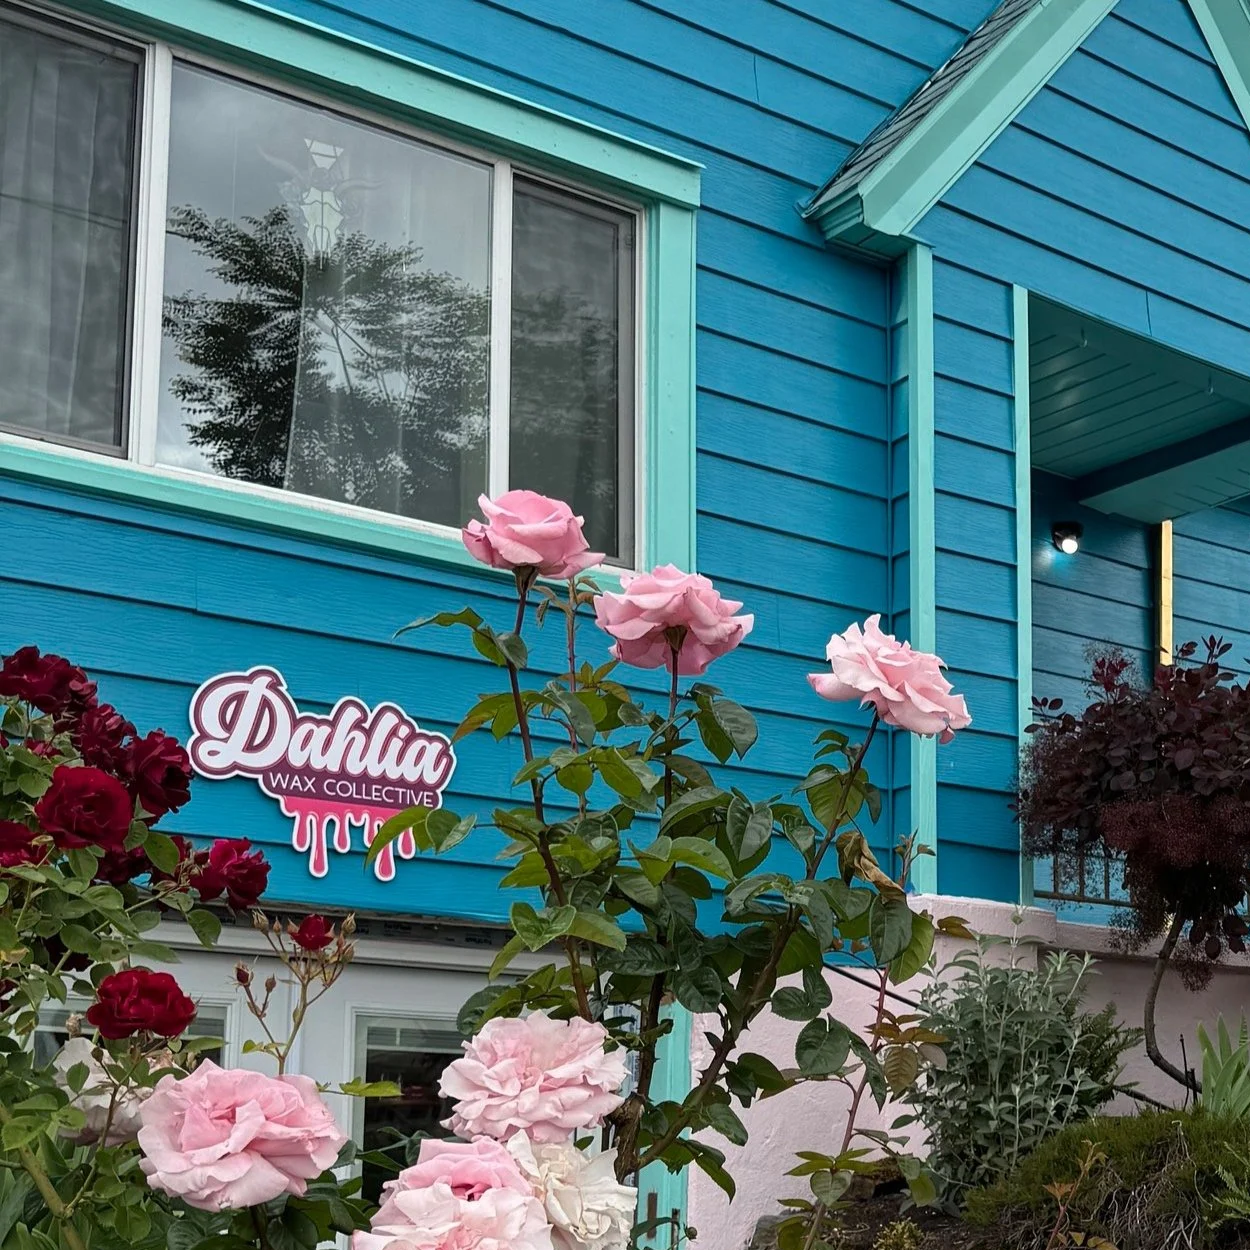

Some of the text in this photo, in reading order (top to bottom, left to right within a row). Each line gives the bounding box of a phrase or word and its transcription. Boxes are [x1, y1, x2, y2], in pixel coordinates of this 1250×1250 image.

[198, 675, 448, 785] Dahlia
[270, 772, 434, 808] WAX COLLECTIVE
